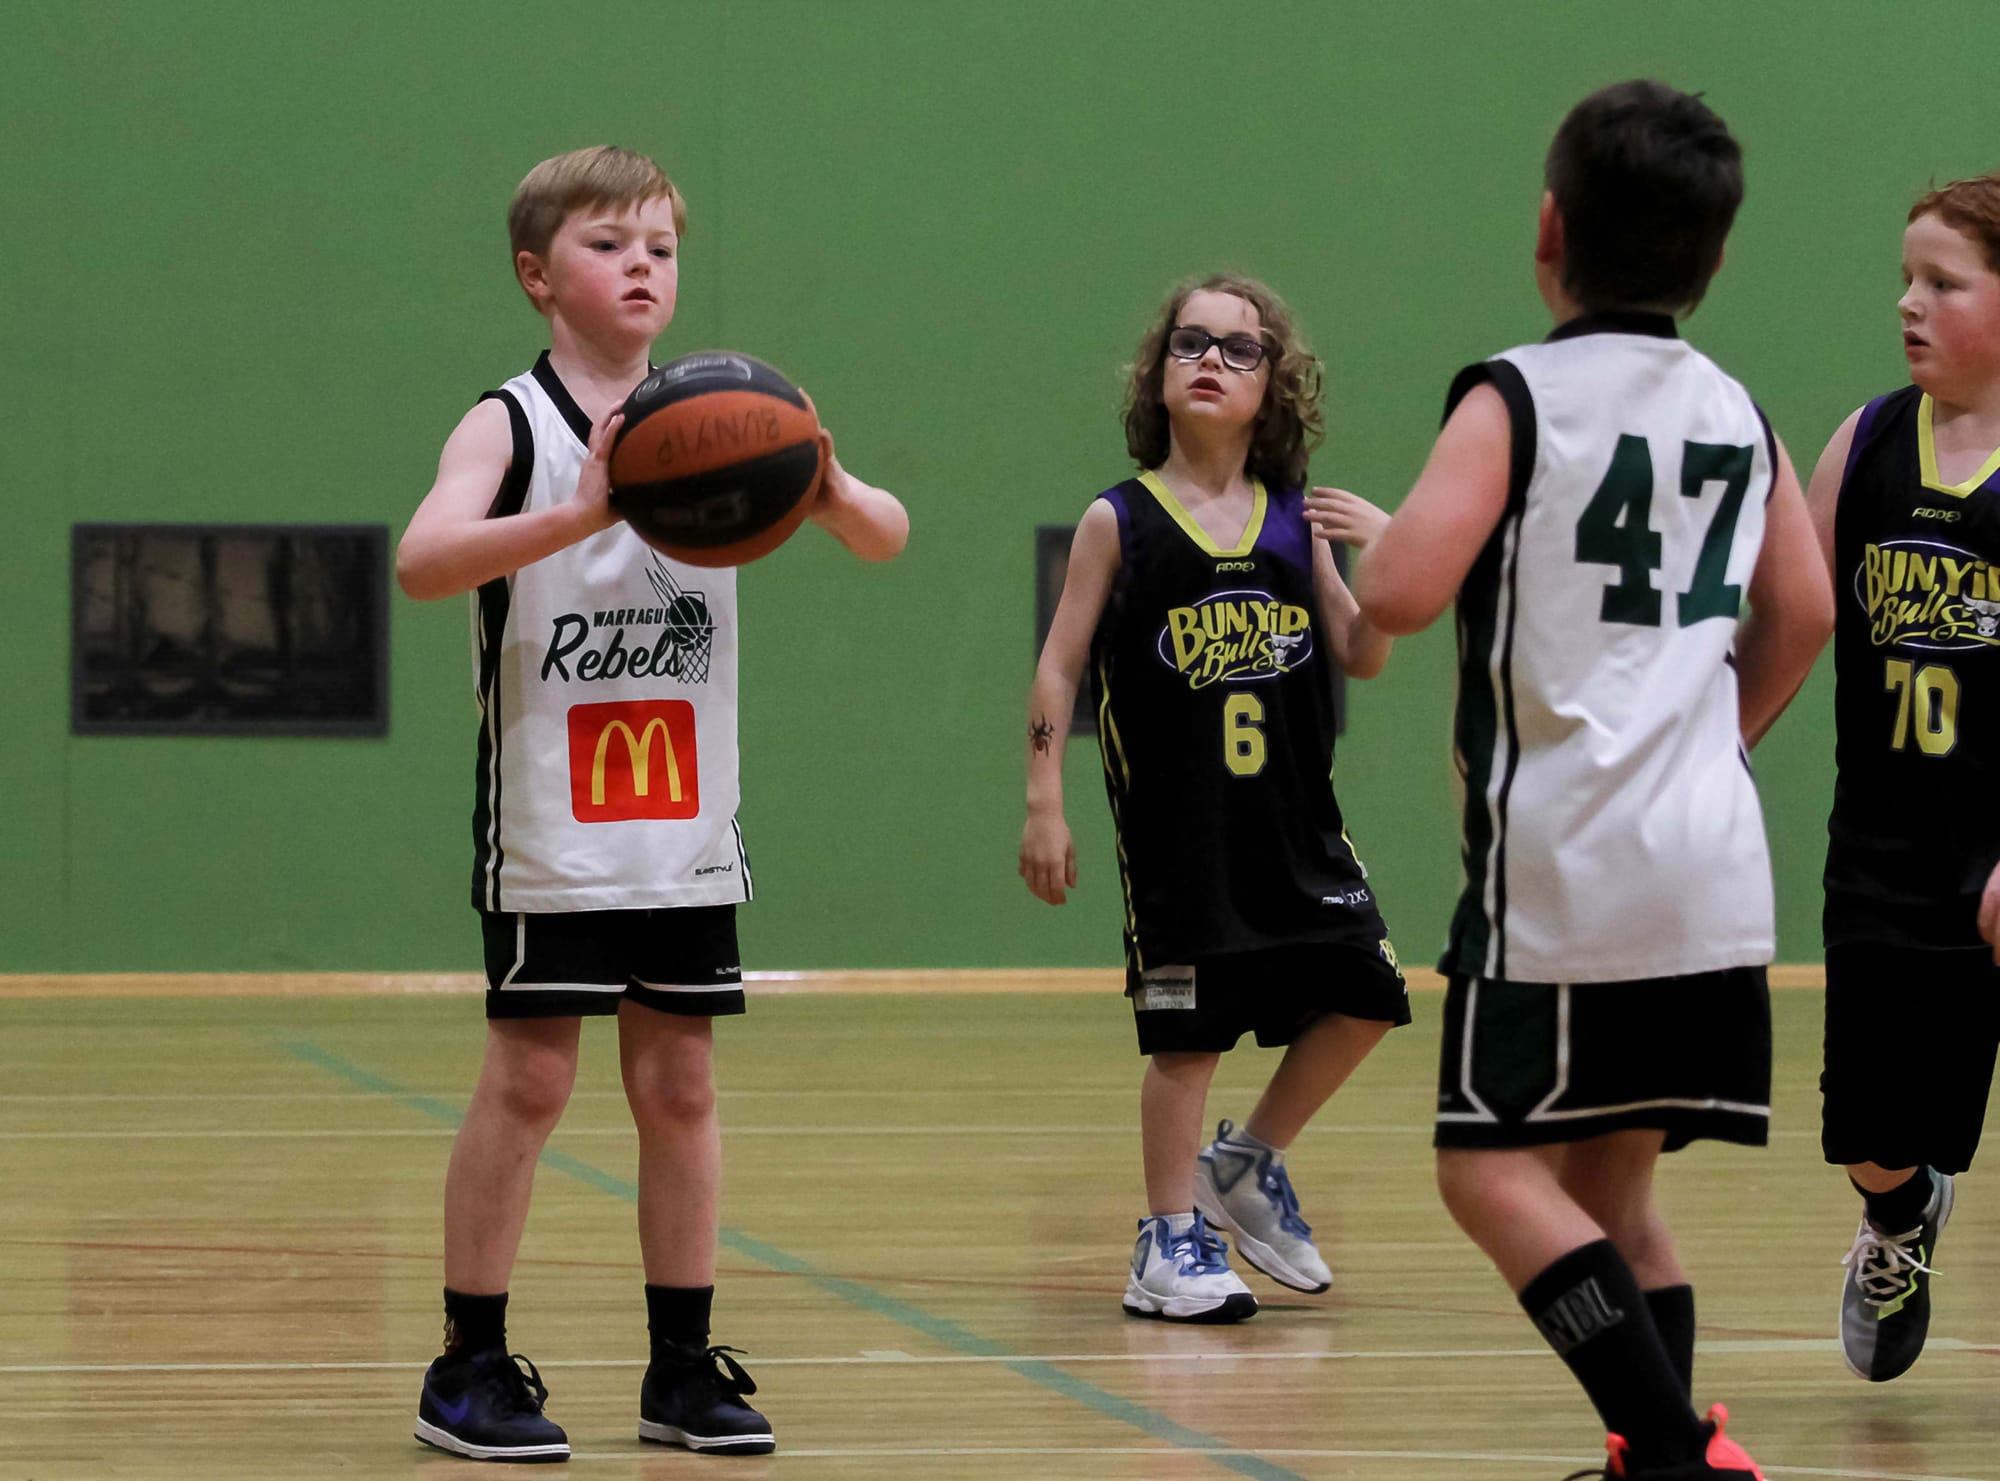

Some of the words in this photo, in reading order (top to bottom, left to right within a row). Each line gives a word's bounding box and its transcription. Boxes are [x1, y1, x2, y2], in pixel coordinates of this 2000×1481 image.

[658, 408, 781, 466] BUNYIP
[1575, 433, 1754, 628] 47
[541, 613, 684, 683] Rebels
[1223, 691, 1267, 777] 6
[1884, 657, 1961, 758] 70
[1346, 889, 1369, 905] 2XS
